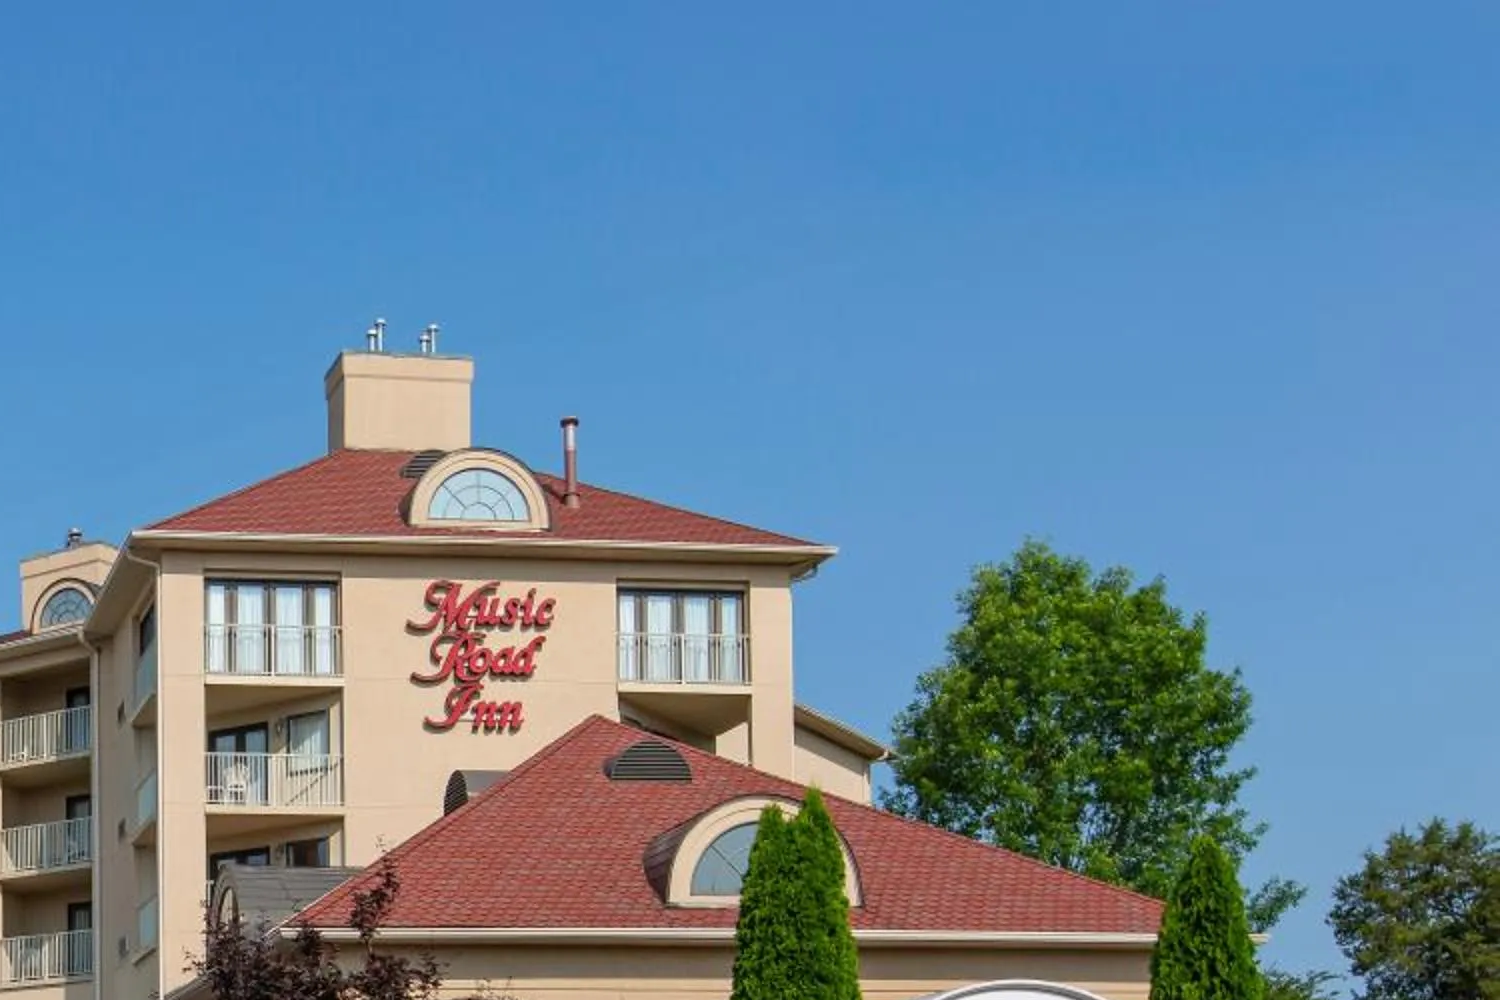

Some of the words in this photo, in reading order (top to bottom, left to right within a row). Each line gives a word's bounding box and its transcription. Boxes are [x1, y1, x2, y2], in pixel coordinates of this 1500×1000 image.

[405, 580, 556, 633] Music
[410, 632, 546, 685] Road
[423, 683, 524, 735] Inn
